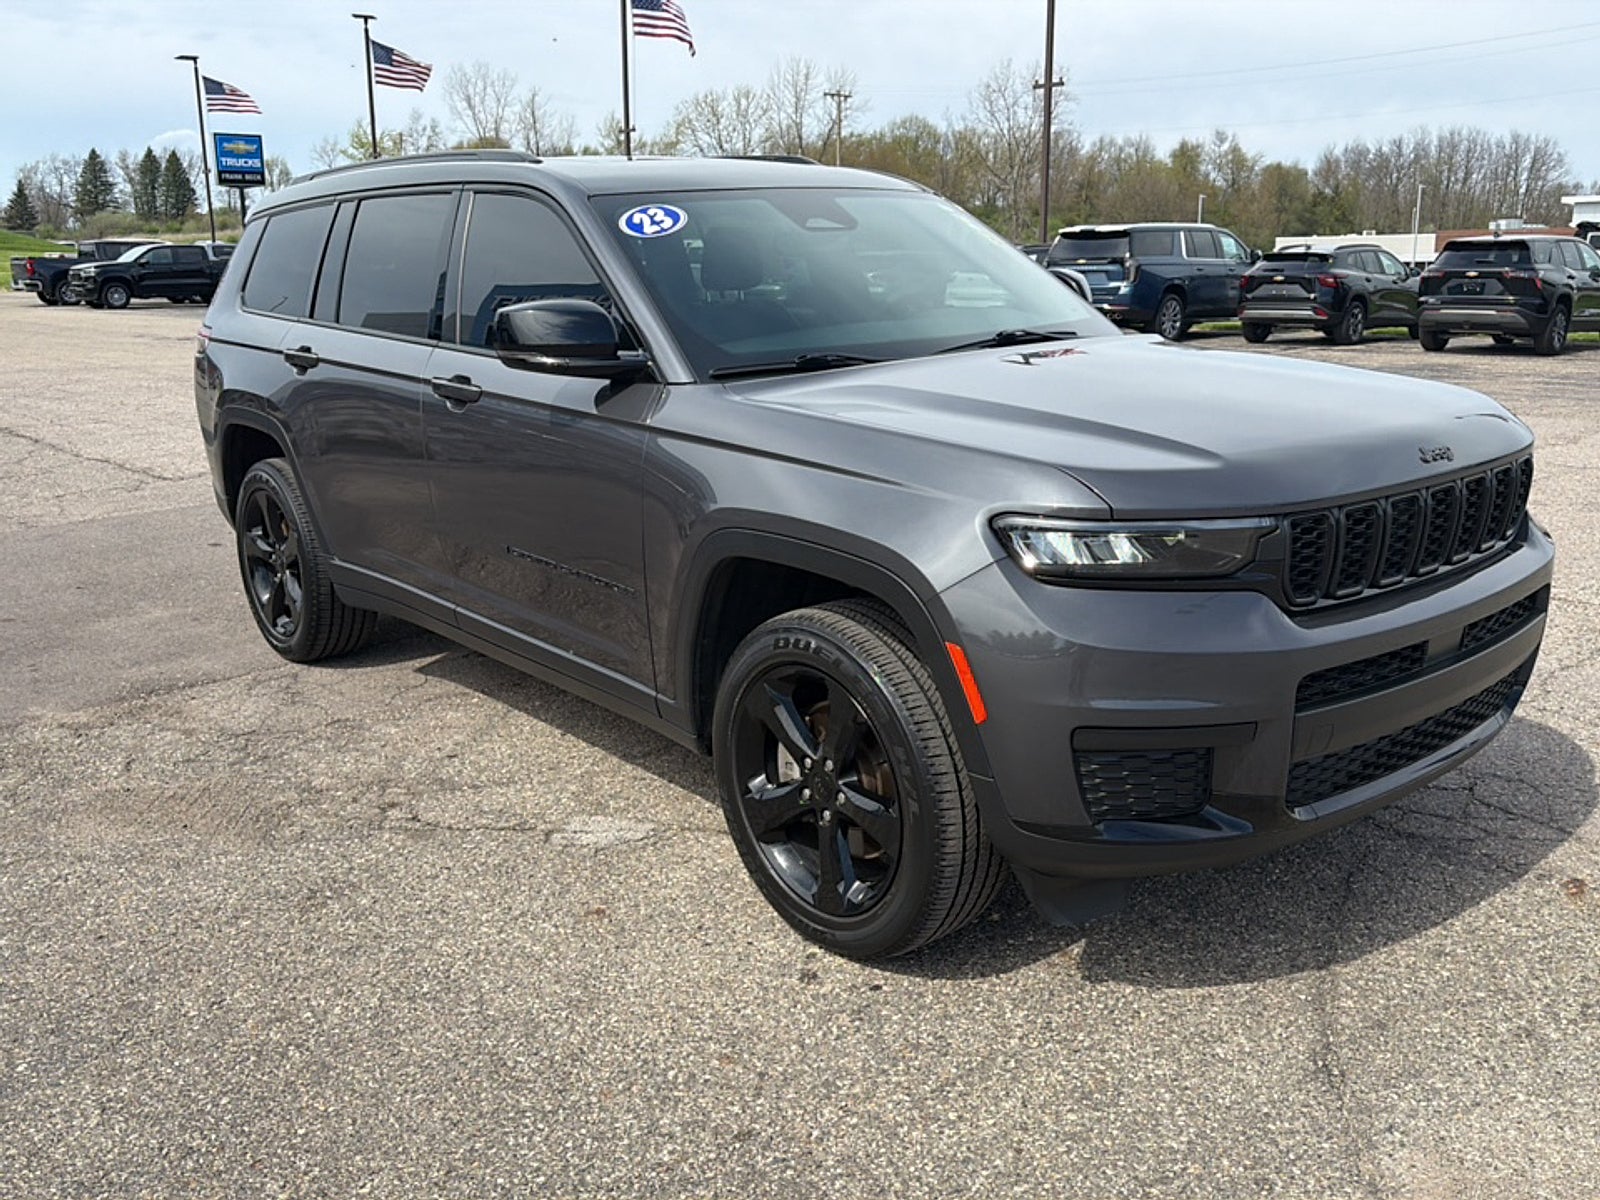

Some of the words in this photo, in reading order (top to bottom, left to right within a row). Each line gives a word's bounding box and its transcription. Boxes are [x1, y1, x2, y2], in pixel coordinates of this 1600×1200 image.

[219, 157, 262, 168] TRUCKS
[632, 208, 673, 235] 23
[1418, 446, 1455, 464] Jeep
